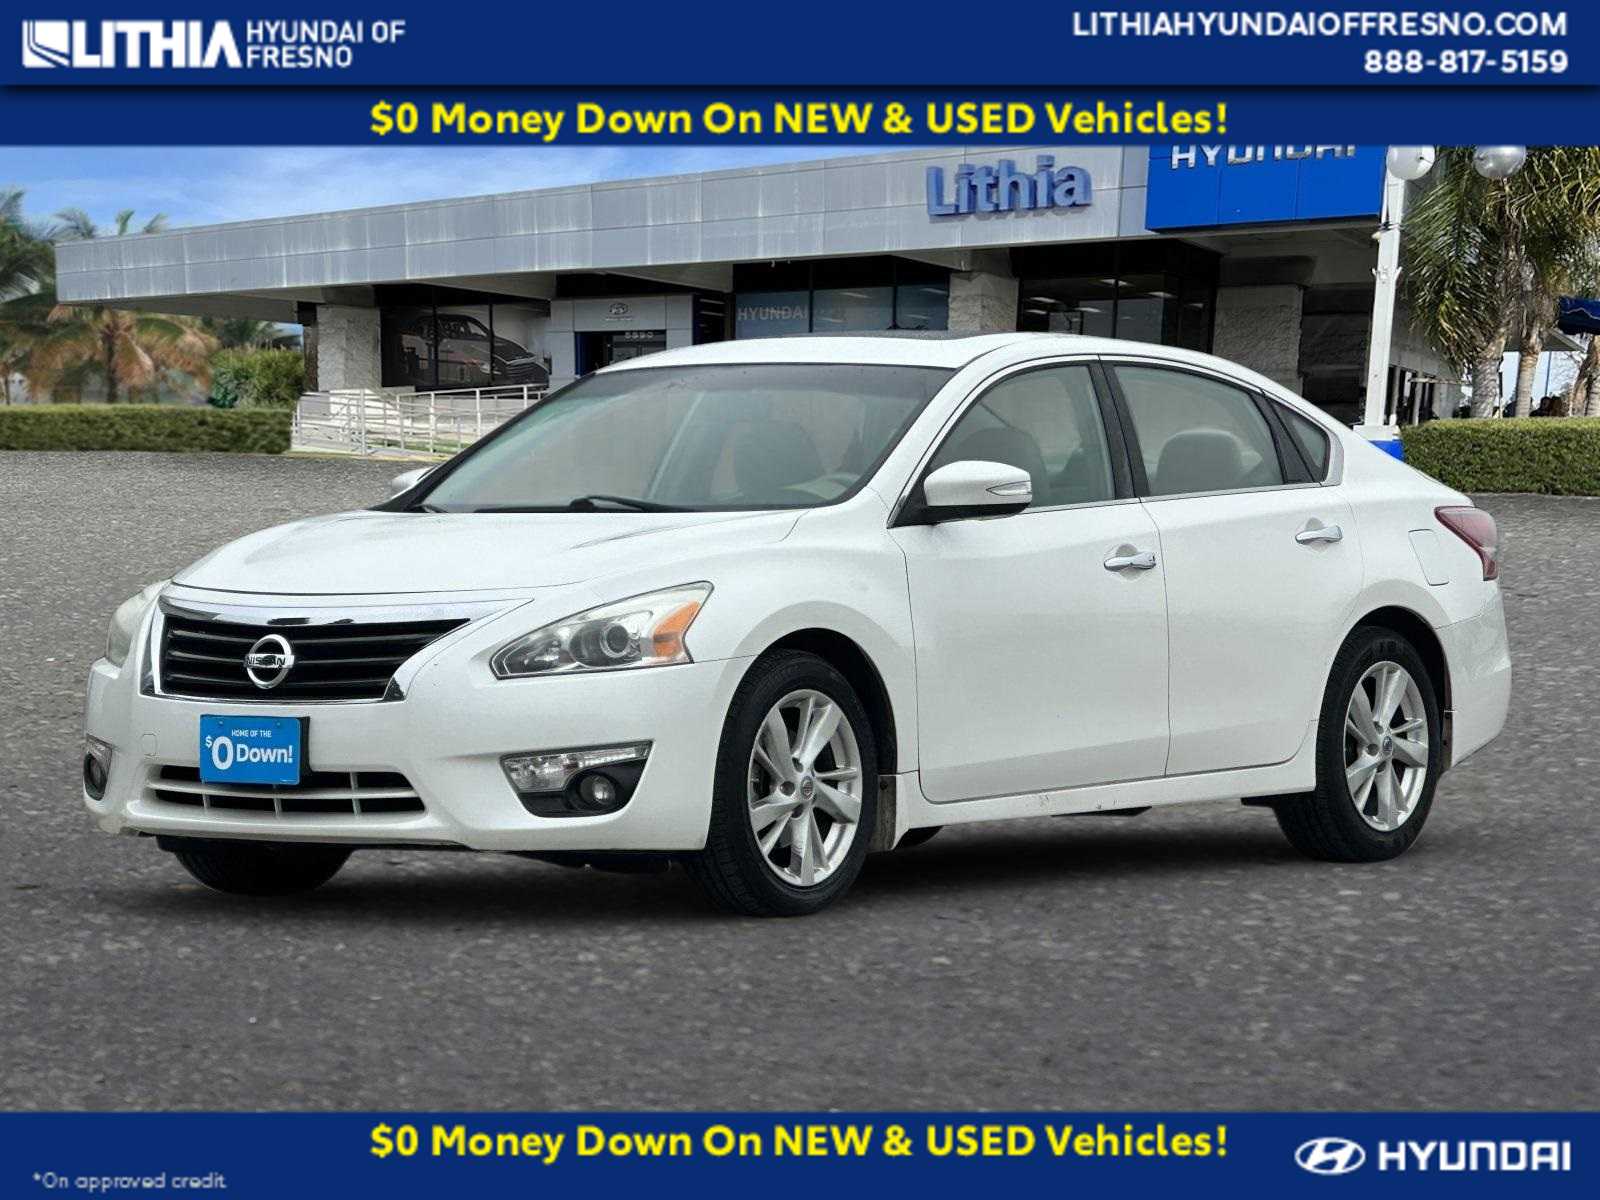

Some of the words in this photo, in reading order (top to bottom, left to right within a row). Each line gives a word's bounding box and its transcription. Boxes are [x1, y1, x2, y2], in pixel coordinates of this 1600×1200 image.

[926, 155, 1093, 216] Lithia
[737, 305, 808, 320] HYUNDAI
[246, 655, 286, 666] NISSAN
[231, 729, 248, 737] HOME
[260, 730, 272, 738] THE
[236, 743, 293, 763] Down!
